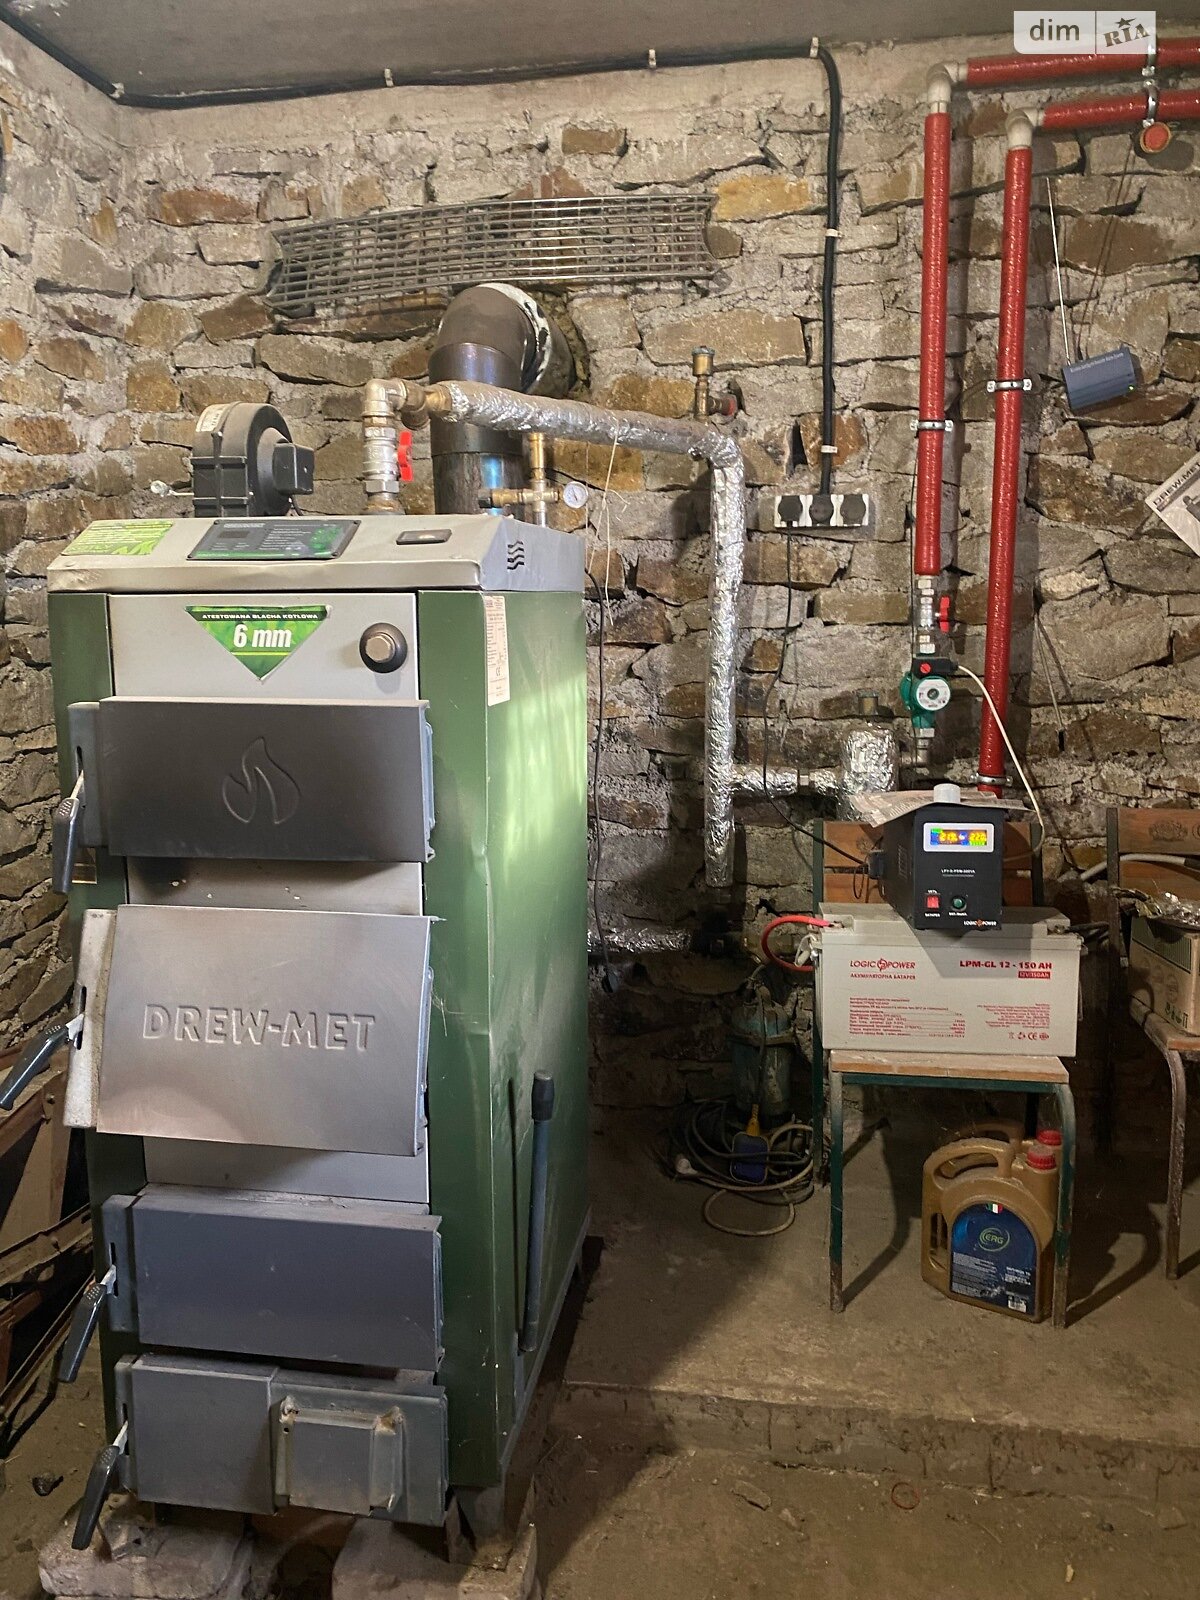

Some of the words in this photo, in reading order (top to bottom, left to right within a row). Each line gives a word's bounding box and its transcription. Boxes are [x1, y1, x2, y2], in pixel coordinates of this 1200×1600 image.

[233, 623, 249, 648] 6
[251, 628, 292, 648] mm
[959, 960, 997, 969] LPM-GL
[999, 961, 1011, 969] 12
[1018, 961, 1037, 969] 150
[1038, 962, 1052, 970] AH
[142, 1003, 376, 1051] DREW-MET
